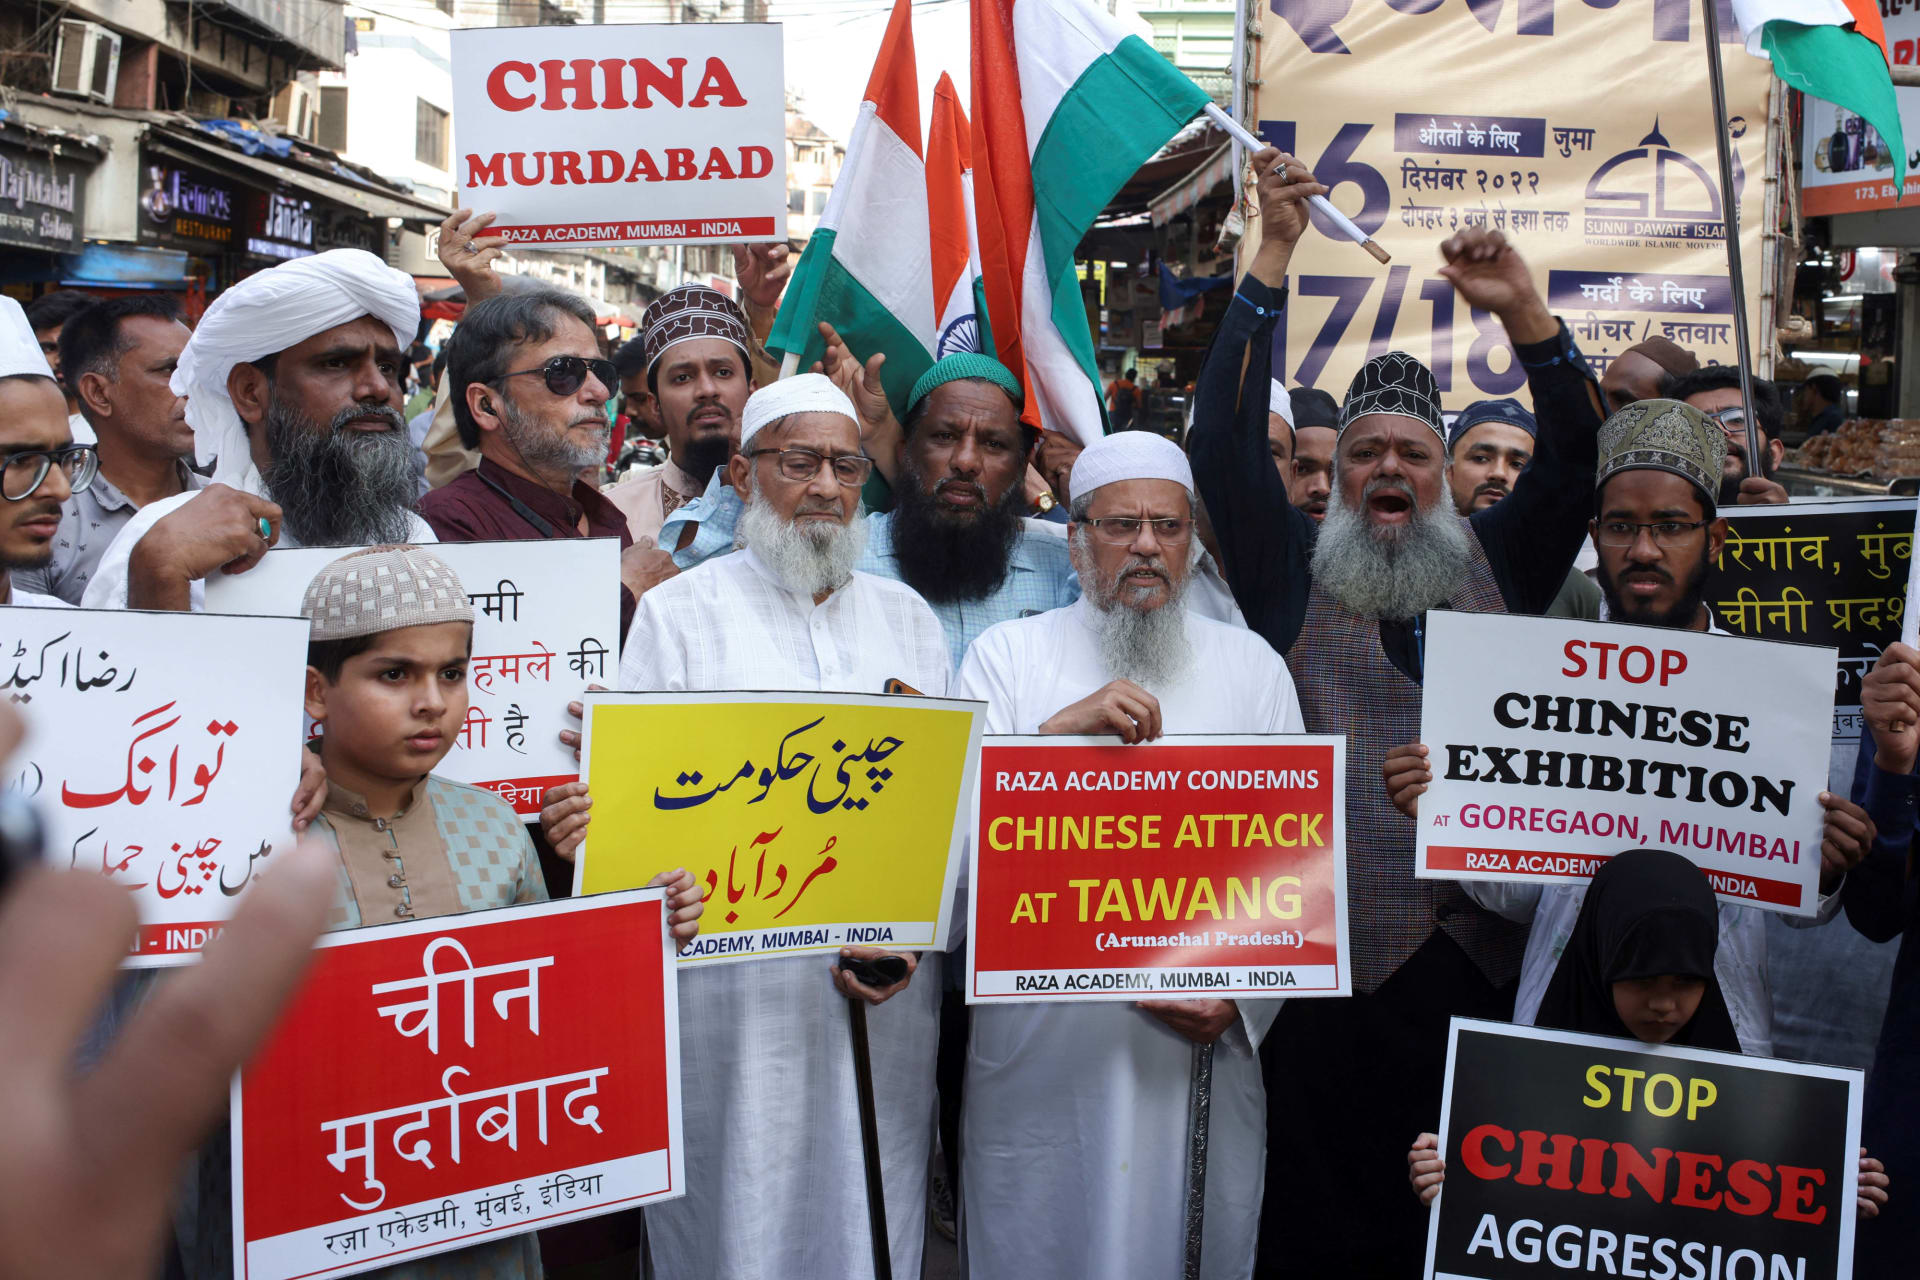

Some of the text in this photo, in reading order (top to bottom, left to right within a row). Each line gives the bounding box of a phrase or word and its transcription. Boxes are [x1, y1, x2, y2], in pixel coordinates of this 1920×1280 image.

[486, 57, 748, 112] CHINA
[1418, 119, 1595, 158] औरतों के लिए जुमा
[465, 146, 774, 188] MURDABAD
[1400, 158, 1540, 194] दिसंबर २०२२
[25, 170, 75, 214] Mahal
[1855, 186, 1879, 201] 173,
[40, 212, 73, 240] Salon
[176, 218, 232, 240] RESTAURANT
[501, 228, 541, 242] RAZA
[544, 226, 622, 242] ACADEMY,
[626, 224, 686, 238] MUMBAI
[701, 222, 742, 236] INDIA
[1400, 198, 1444, 229] दोपहर
[1449, 207, 1458, 231] ३
[1492, 200, 1508, 230] से
[1511, 209, 1539, 234] इशा
[1543, 210, 1570, 232] तक
[1586, 221, 1627, 234] SUNNI
[1634, 223, 1688, 237] DAWATE
[1585, 238, 1641, 248] WORLDWIDE
[1645, 240, 1682, 249] ISLAMIC
[1580, 276, 1706, 309] मर्दों के लिए
[1717, 587, 1813, 634] चीनी
[471, 638, 609, 695] हमले की
[1562, 639, 1688, 686] STOP
[504, 704, 530, 754] है
[1493, 692, 1750, 753] CHINESE
[61, 700, 239, 808] توانگ
[653, 716, 905, 815] چینی حکومت
[995, 769, 1319, 792] RAZA ACADEMY CONDEMNS
[1444, 744, 1796, 816] EXHIBITION
[988, 813, 1325, 852] CHINESE ATTACK
[1433, 803, 1801, 865] AT GOREGAON, MUMBAI
[156, 837, 223, 899] چینی
[1466, 851, 1512, 871] RAZA
[1709, 873, 1759, 898] INDIA
[1010, 876, 1302, 924] AT TAWANG
[676, 935, 756, 958] CADEMY,
[762, 928, 829, 949] MUMBAI
[846, 926, 894, 943] INDIA
[1095, 929, 1304, 951] (Arunachal Pradesh)
[372, 937, 555, 1055] चीन
[1015, 975, 1059, 991] RAZA
[1064, 973, 1154, 991] ACADEMY,
[1160, 972, 1230, 988] MUMBAI
[1248, 970, 1297, 987] INDIA
[1582, 1064, 1718, 1121] STOP
[320, 1065, 609, 1212] मुर्दाबाद
[1460, 1124, 1827, 1225] CHINESE
[324, 1173, 604, 1255] रज़ा एकेडमी, मुंबई, इंडिया
[1466, 1213, 1807, 1280] AGGRESSION
